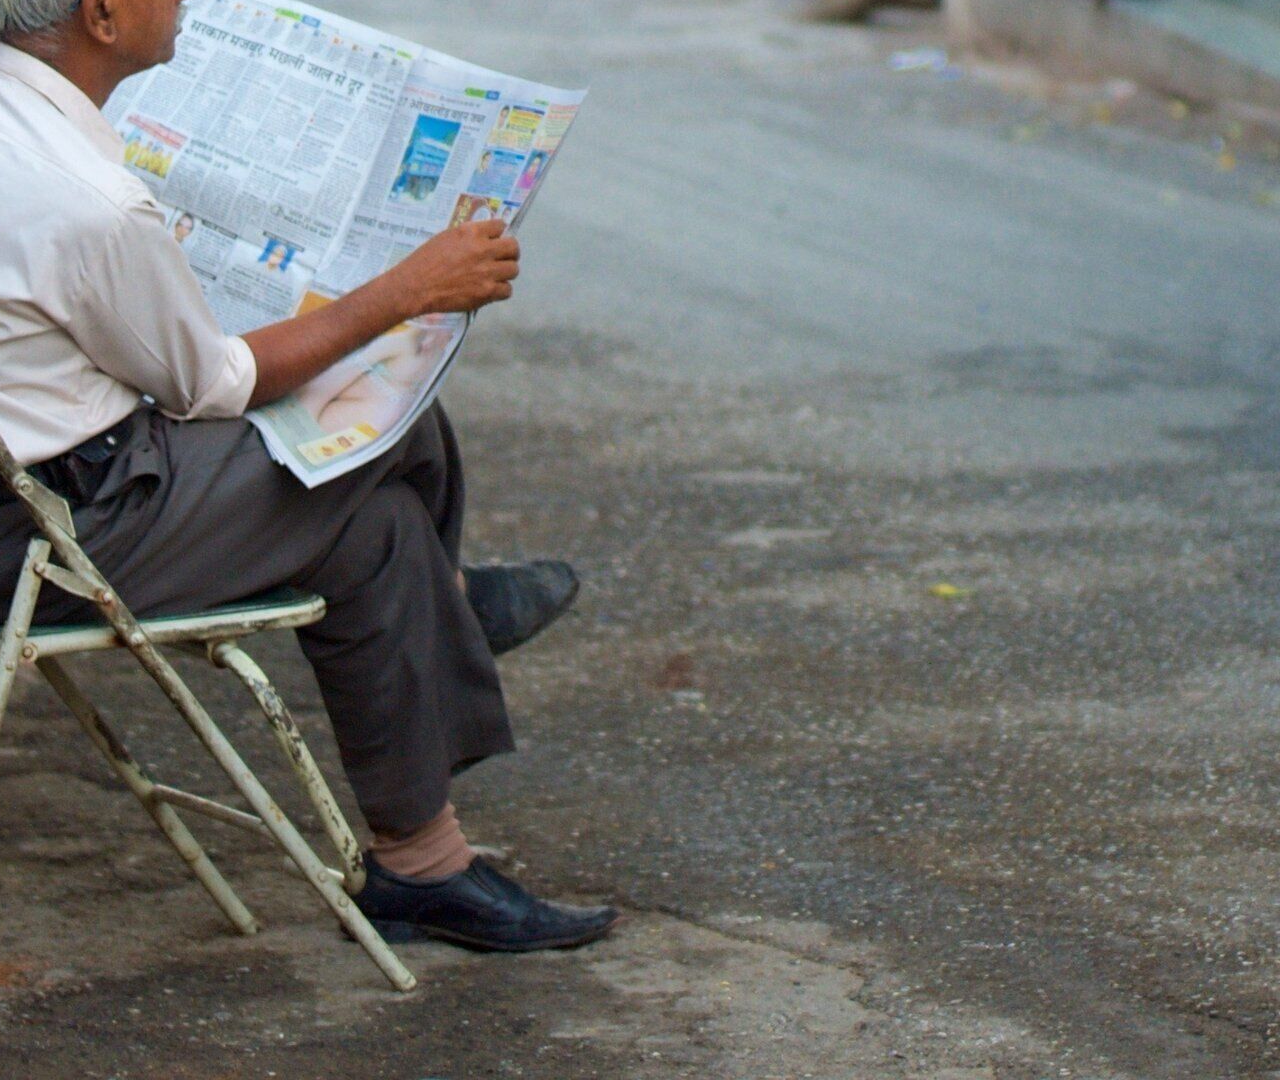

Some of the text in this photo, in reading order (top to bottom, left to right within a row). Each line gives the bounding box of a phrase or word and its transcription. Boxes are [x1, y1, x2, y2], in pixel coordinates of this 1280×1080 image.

[190, 19, 230, 42] सरकार
[269, 46, 306, 71] मछली
[307, 61, 333, 81] जाल
[334, 71, 348, 86] से
[348, 77, 365, 96] दूर
